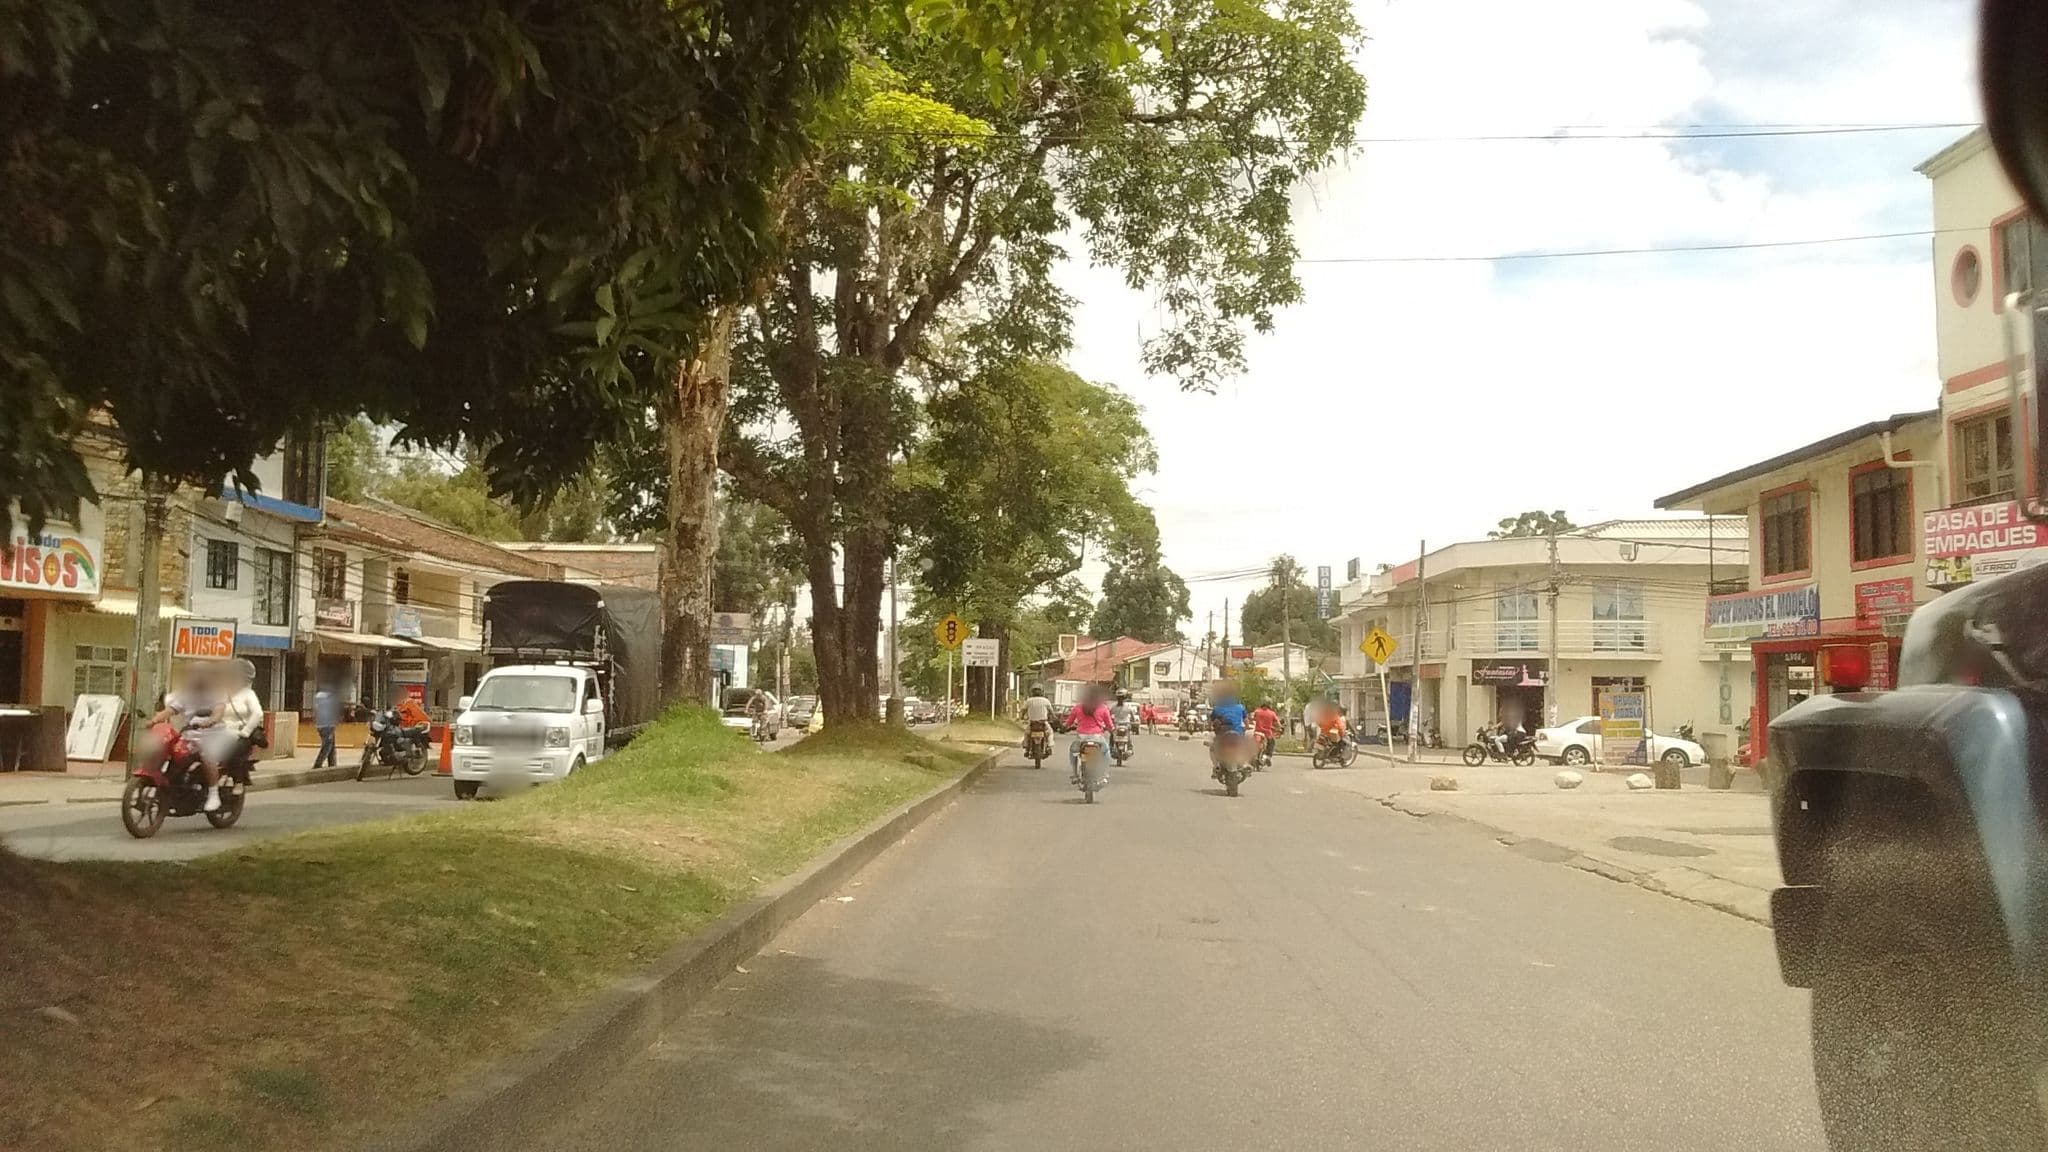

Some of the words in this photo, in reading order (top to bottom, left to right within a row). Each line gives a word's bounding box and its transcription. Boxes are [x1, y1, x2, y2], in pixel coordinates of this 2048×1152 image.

[1923, 511, 1978, 534] CASA
[1981, 506, 2009, 527] DE
[1925, 525, 2038, 555] EMPAQUES
[1320, 567, 1330, 619] HOTEL
[1765, 594, 1776, 620] EL
[1777, 588, 1818, 618] MODELO
[176, 627, 233, 656] AVISOS
[191, 626, 217, 635] TODO
